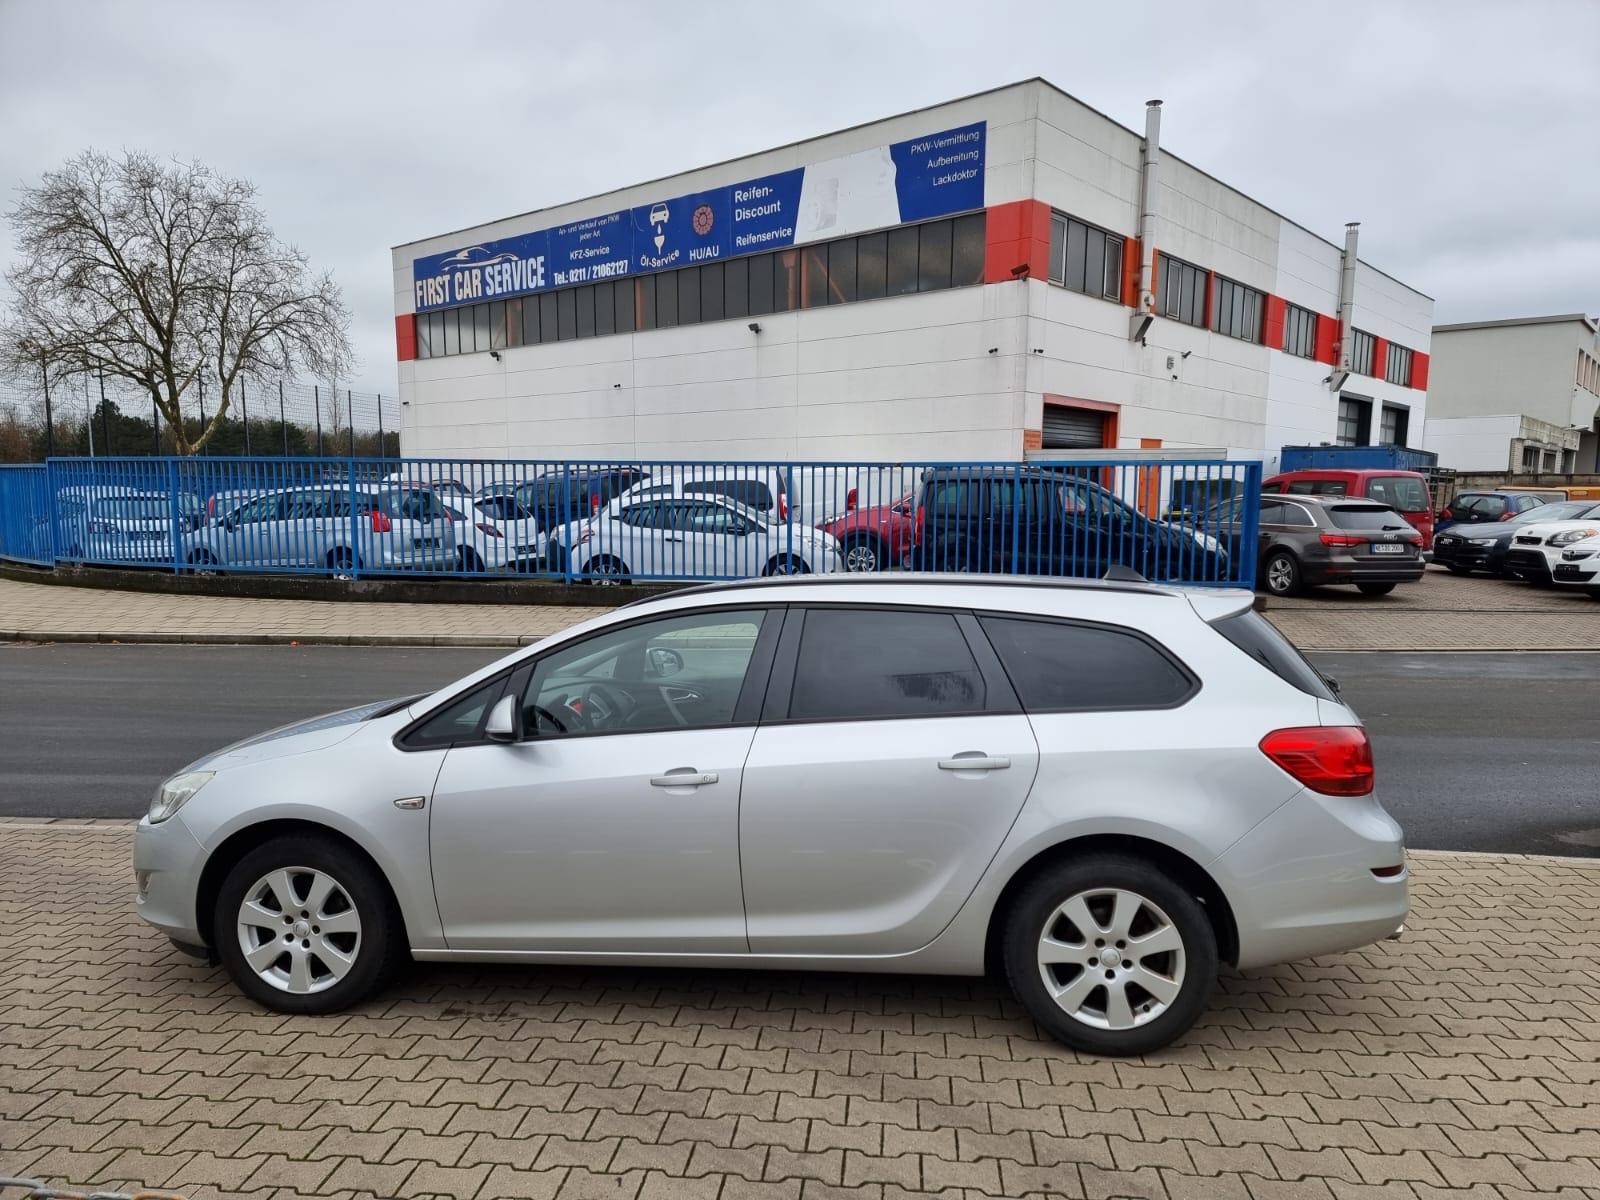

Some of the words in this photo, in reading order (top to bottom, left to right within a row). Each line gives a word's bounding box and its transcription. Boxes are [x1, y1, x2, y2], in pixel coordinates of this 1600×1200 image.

[911, 131, 980, 155] PKW-Vermittlung
[927, 150, 979, 169] Aufbereitung
[932, 168, 978, 187] Lackdoktor
[735, 186, 774, 204] Reifen-
[735, 200, 781, 222] Discount
[736, 227, 793, 247] Reifenservice
[569, 246, 610, 261] KFZ-Service
[640, 249, 680, 268] Öl-Service
[689, 244, 720, 261] HU/AU
[569, 266, 587, 282] 0211
[592, 259, 629, 279] 21062127
[416, 274, 450, 308] FIRST
[454, 268, 482, 301] CAR
[485, 256, 545, 296] SERVICE
